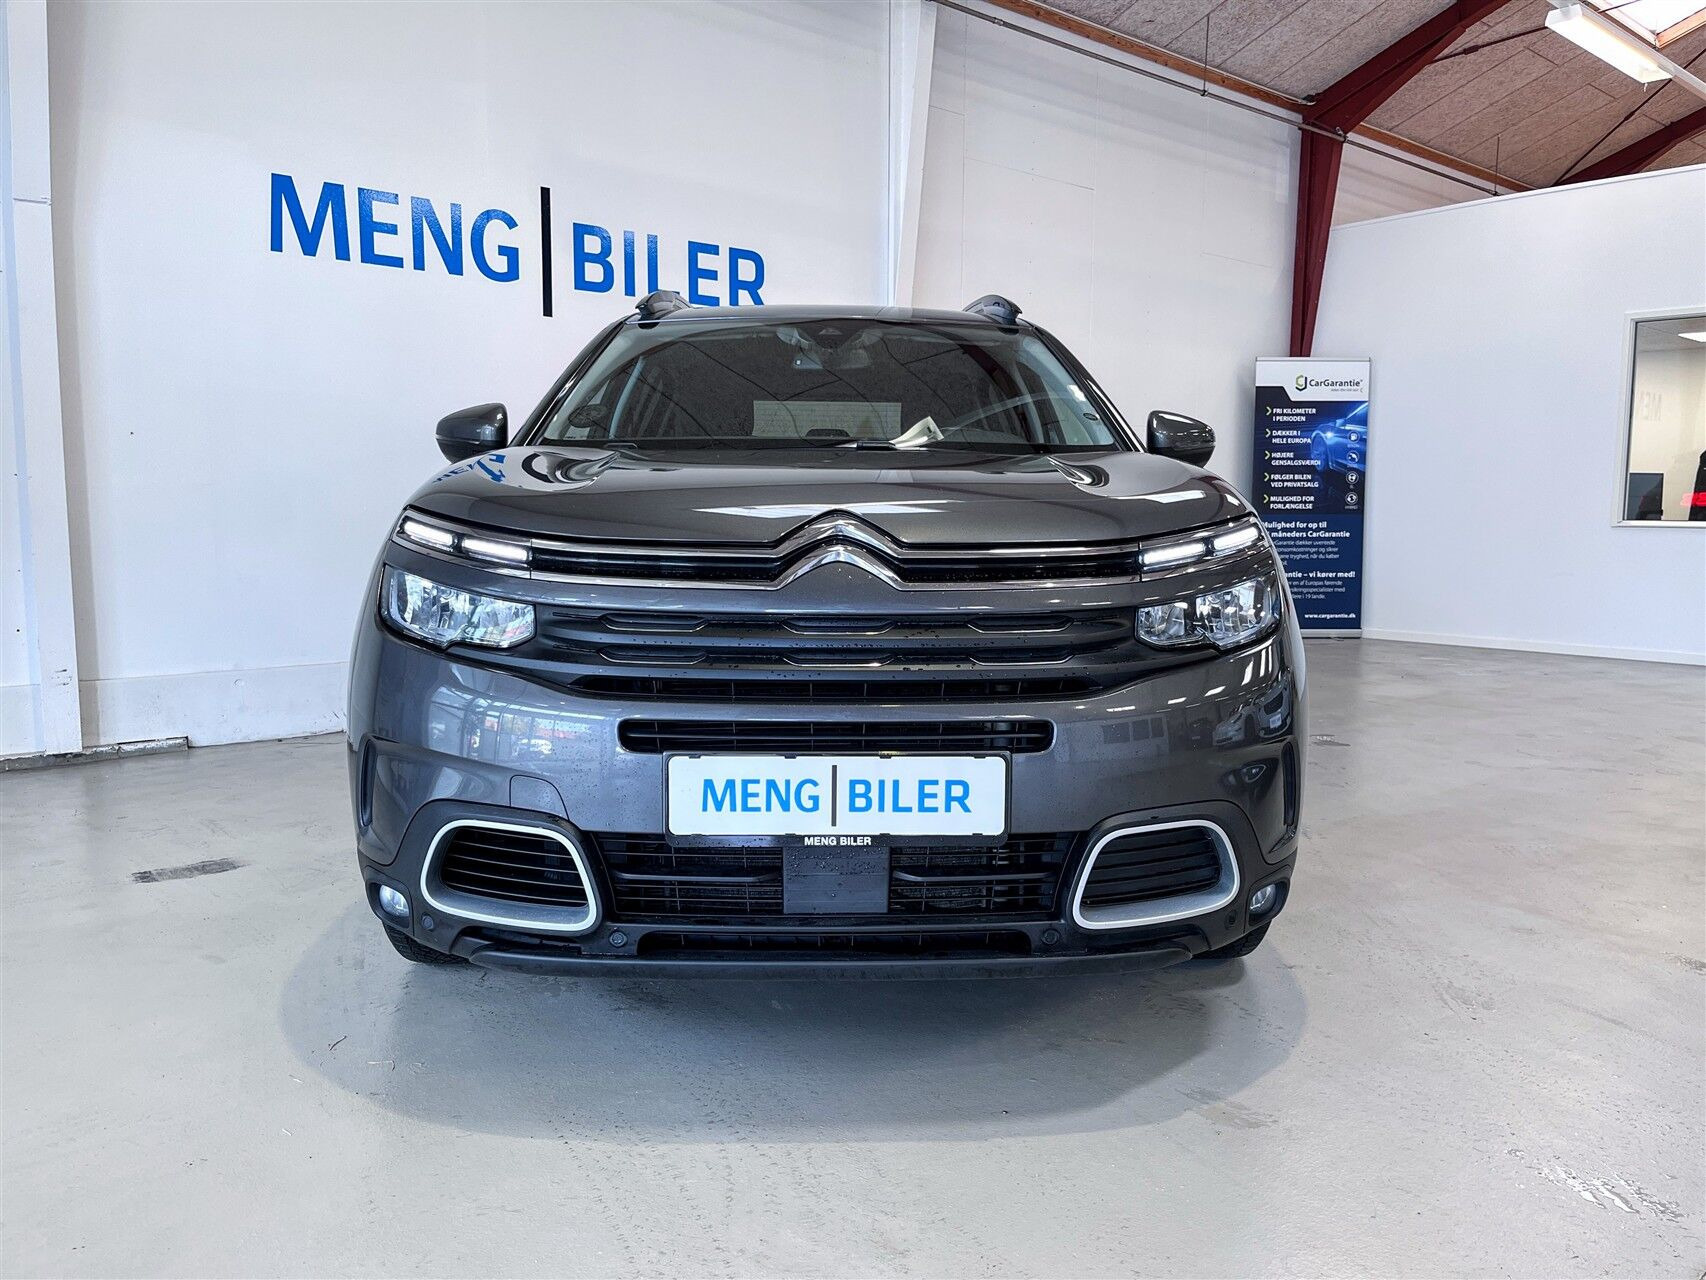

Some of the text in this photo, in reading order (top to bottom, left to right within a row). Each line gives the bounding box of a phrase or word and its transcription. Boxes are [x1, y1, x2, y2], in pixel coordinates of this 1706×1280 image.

[270, 172, 765, 307] MENG BILER
[1309, 379, 1360, 387] CarGarantie
[1262, 521, 1295, 529] Mulighed
[1271, 530, 1306, 538] måneders
[1307, 530, 1350, 538] CarGarantie
[702, 778, 972, 813] MENG BILER
[804, 836, 872, 846] MENG BILER
